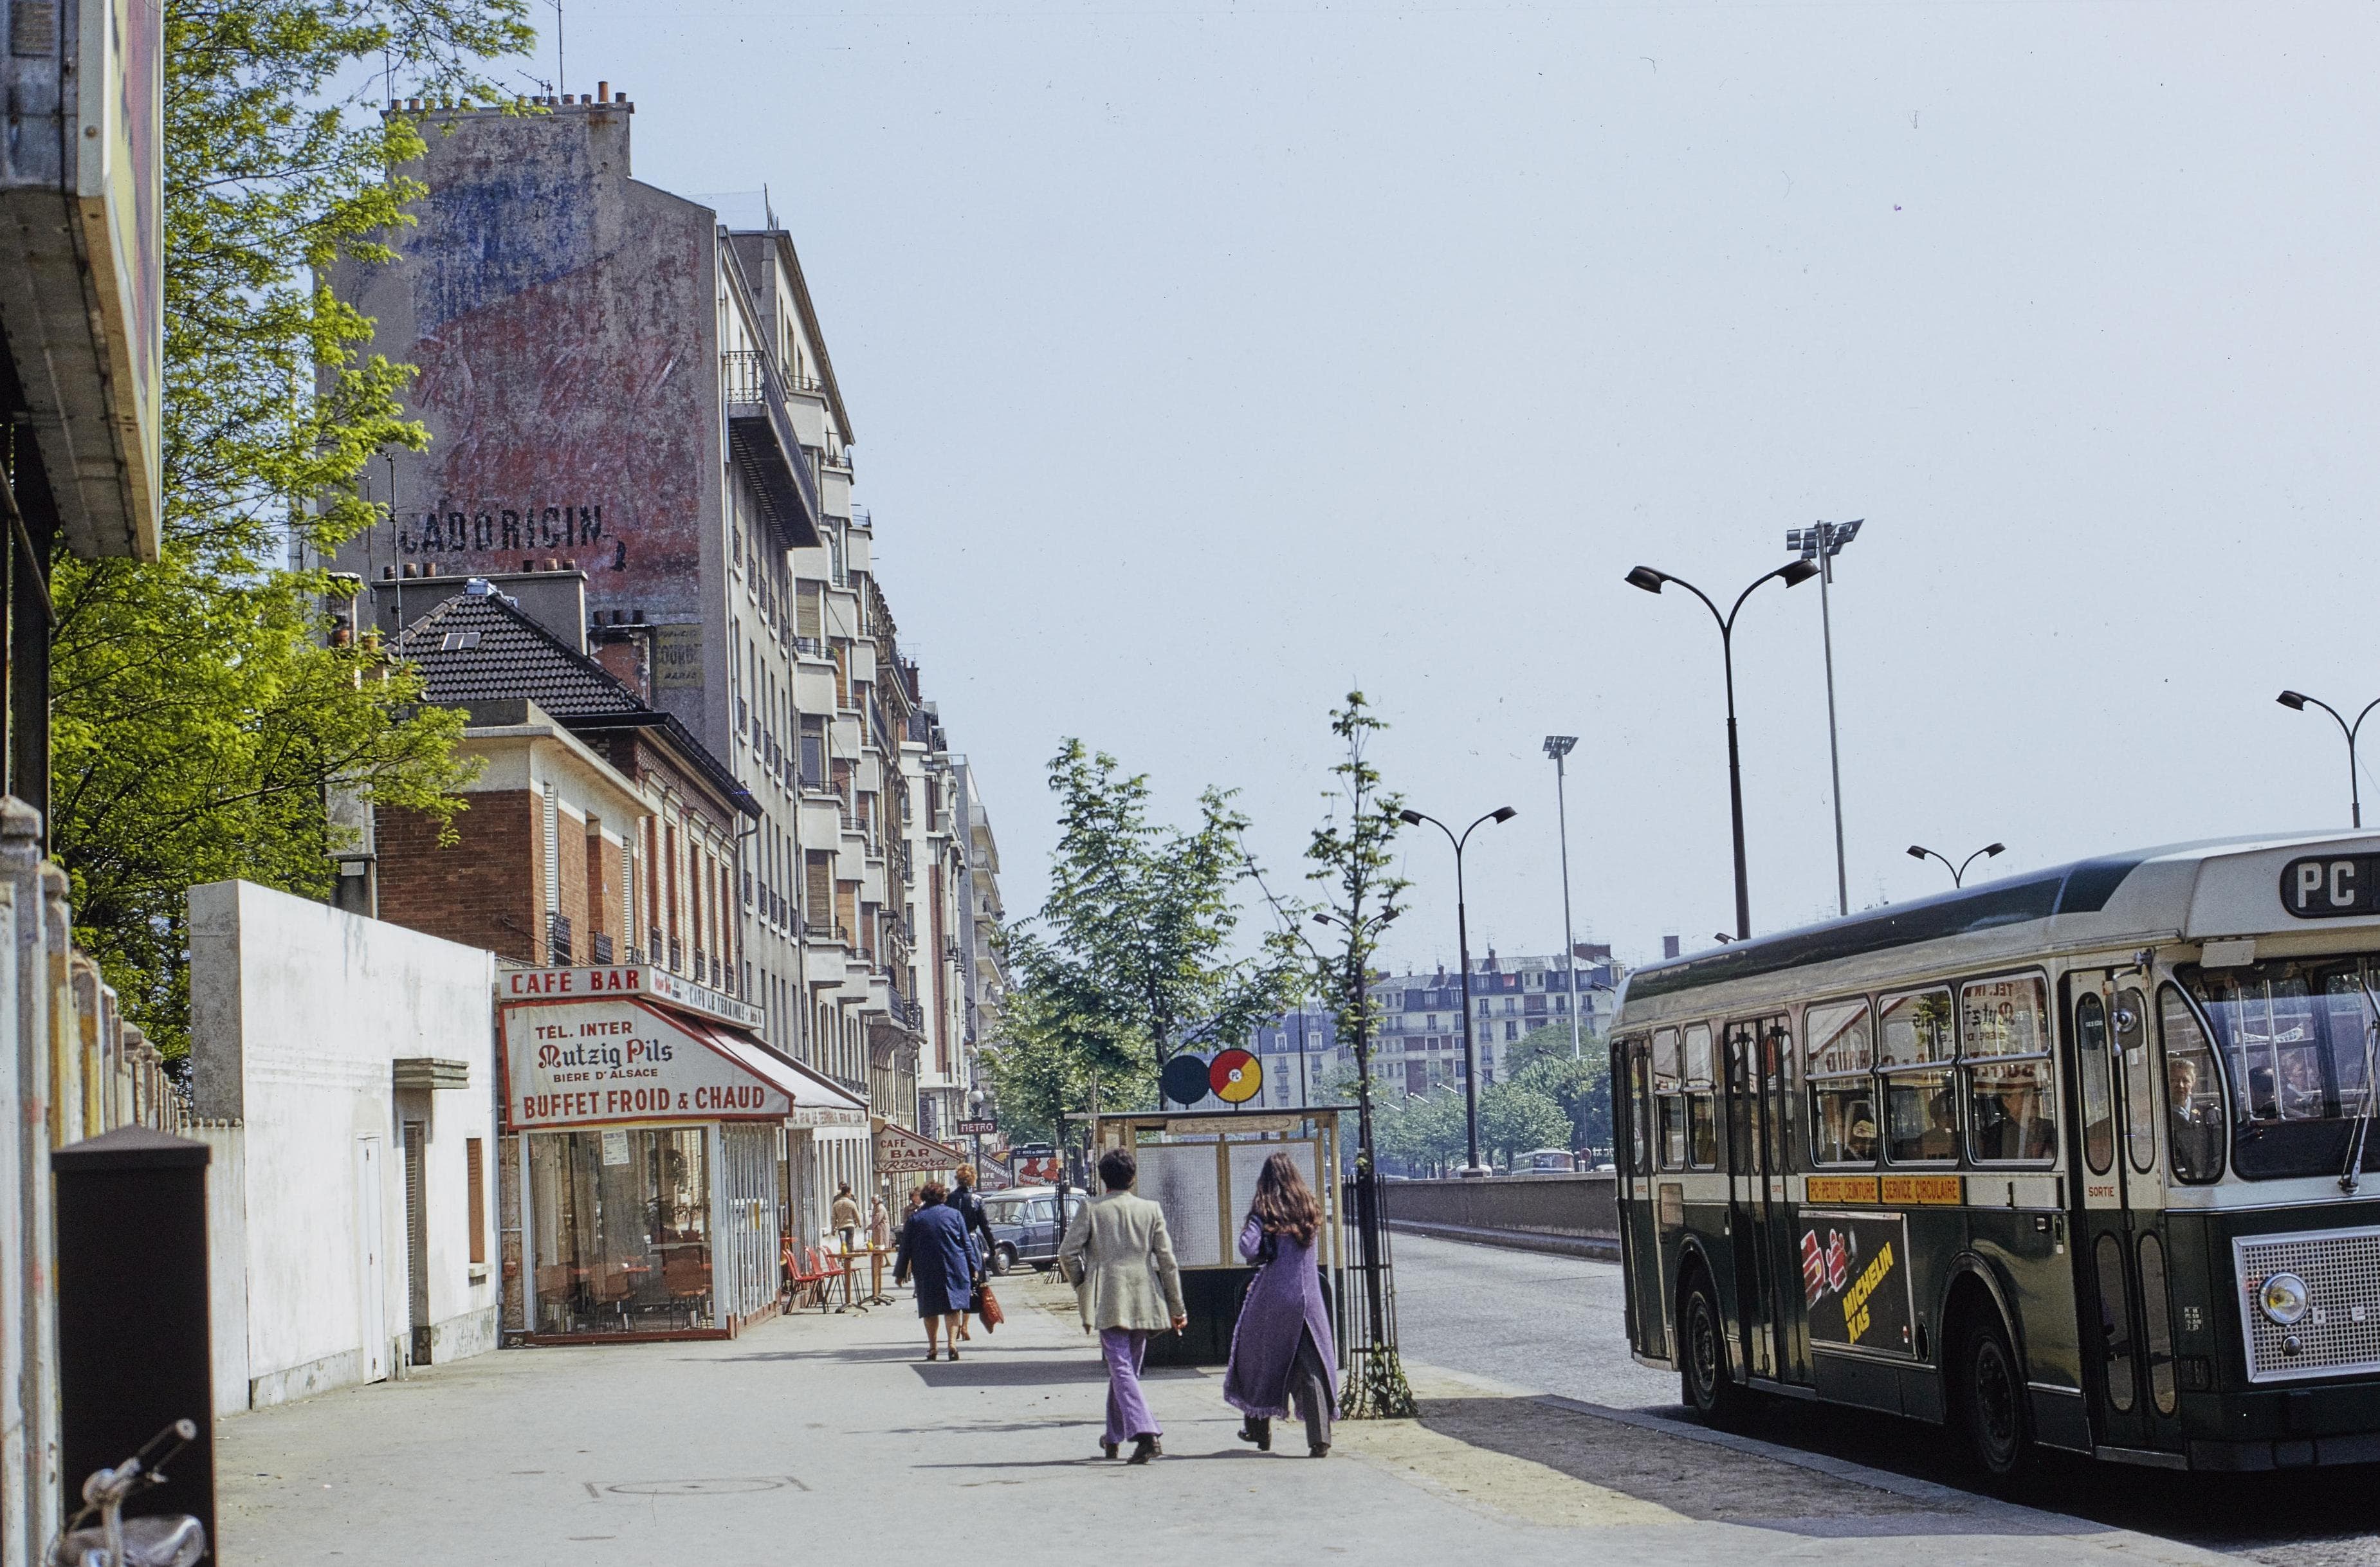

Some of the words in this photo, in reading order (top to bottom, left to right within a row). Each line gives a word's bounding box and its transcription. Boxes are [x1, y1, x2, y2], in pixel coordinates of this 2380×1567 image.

[2297, 861, 2355, 908] PC
[511, 970, 572, 994] CAFÉ
[590, 969, 639, 991] BAR
[535, 1024, 574, 1040] TÉL.
[580, 1022, 632, 1036] INTER
[538, 1042, 622, 1070] Mutzig
[625, 1038, 673, 1063] Pils
[524, 1092, 600, 1119] BUFFET
[607, 1088, 670, 1113] FROID
[677, 1092, 688, 1109] &
[695, 1086, 765, 1108] CHAUD
[881, 1139, 906, 1148] CAFE
[890, 1149, 929, 1158] BAR
[1884, 1180, 1911, 1199] SERVICE
[1916, 1180, 1957, 1200] CIRCULAIRE
[2089, 1186, 2114, 1197] SORTIE
[1842, 1241, 1894, 1323] MICHELIN
[1847, 1304, 1871, 1345] XAS
